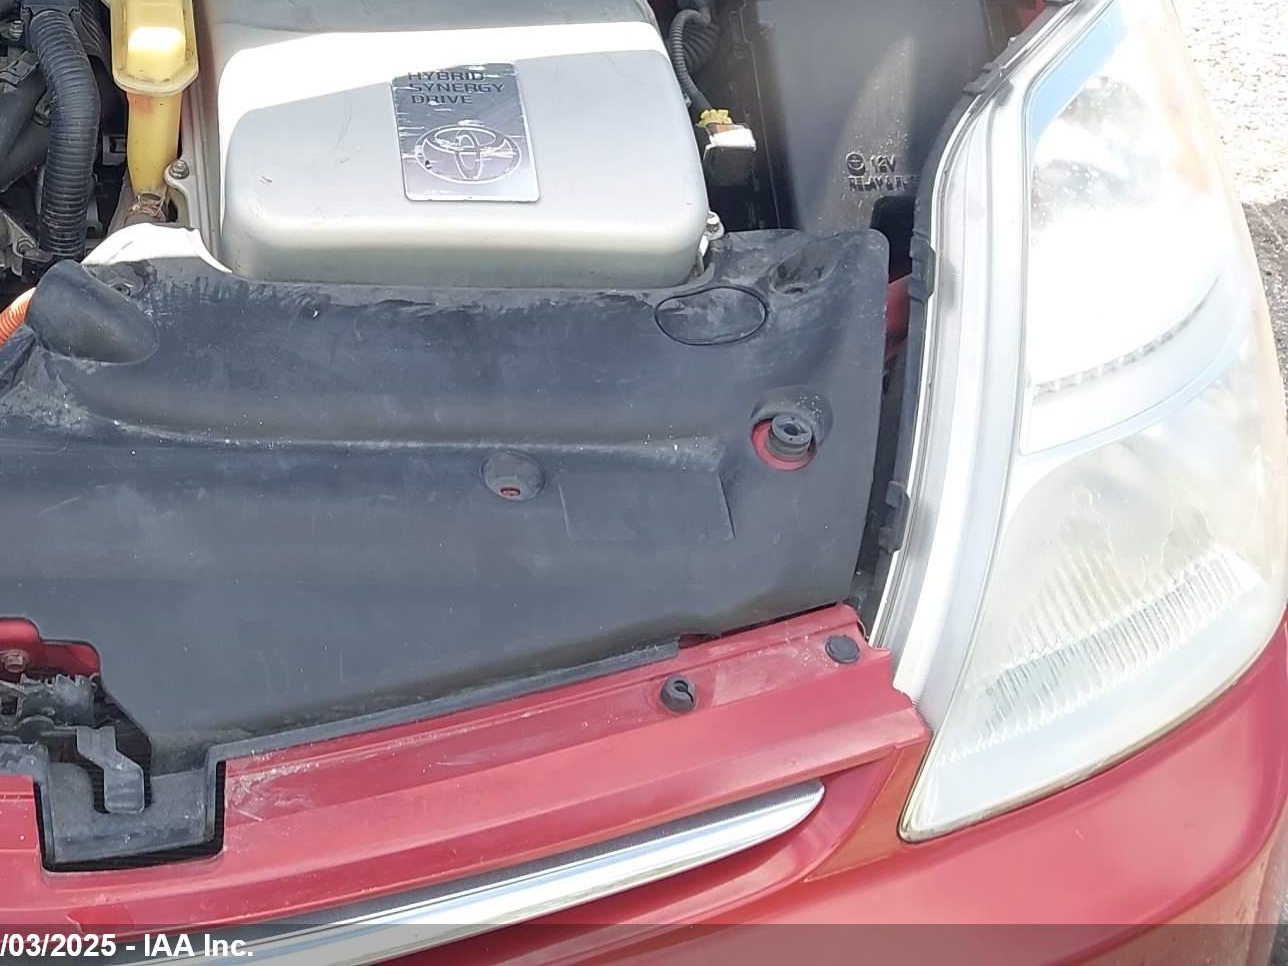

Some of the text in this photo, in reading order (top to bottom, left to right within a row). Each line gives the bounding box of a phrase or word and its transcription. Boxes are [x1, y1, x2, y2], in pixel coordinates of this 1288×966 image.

[407, 71, 484, 81] HYBRID
[409, 82, 505, 93] SYNERGY
[411, 94, 473, 104] DRIVE
[869, 154, 896, 173] 12V
[847, 175, 883, 191] RELAY
